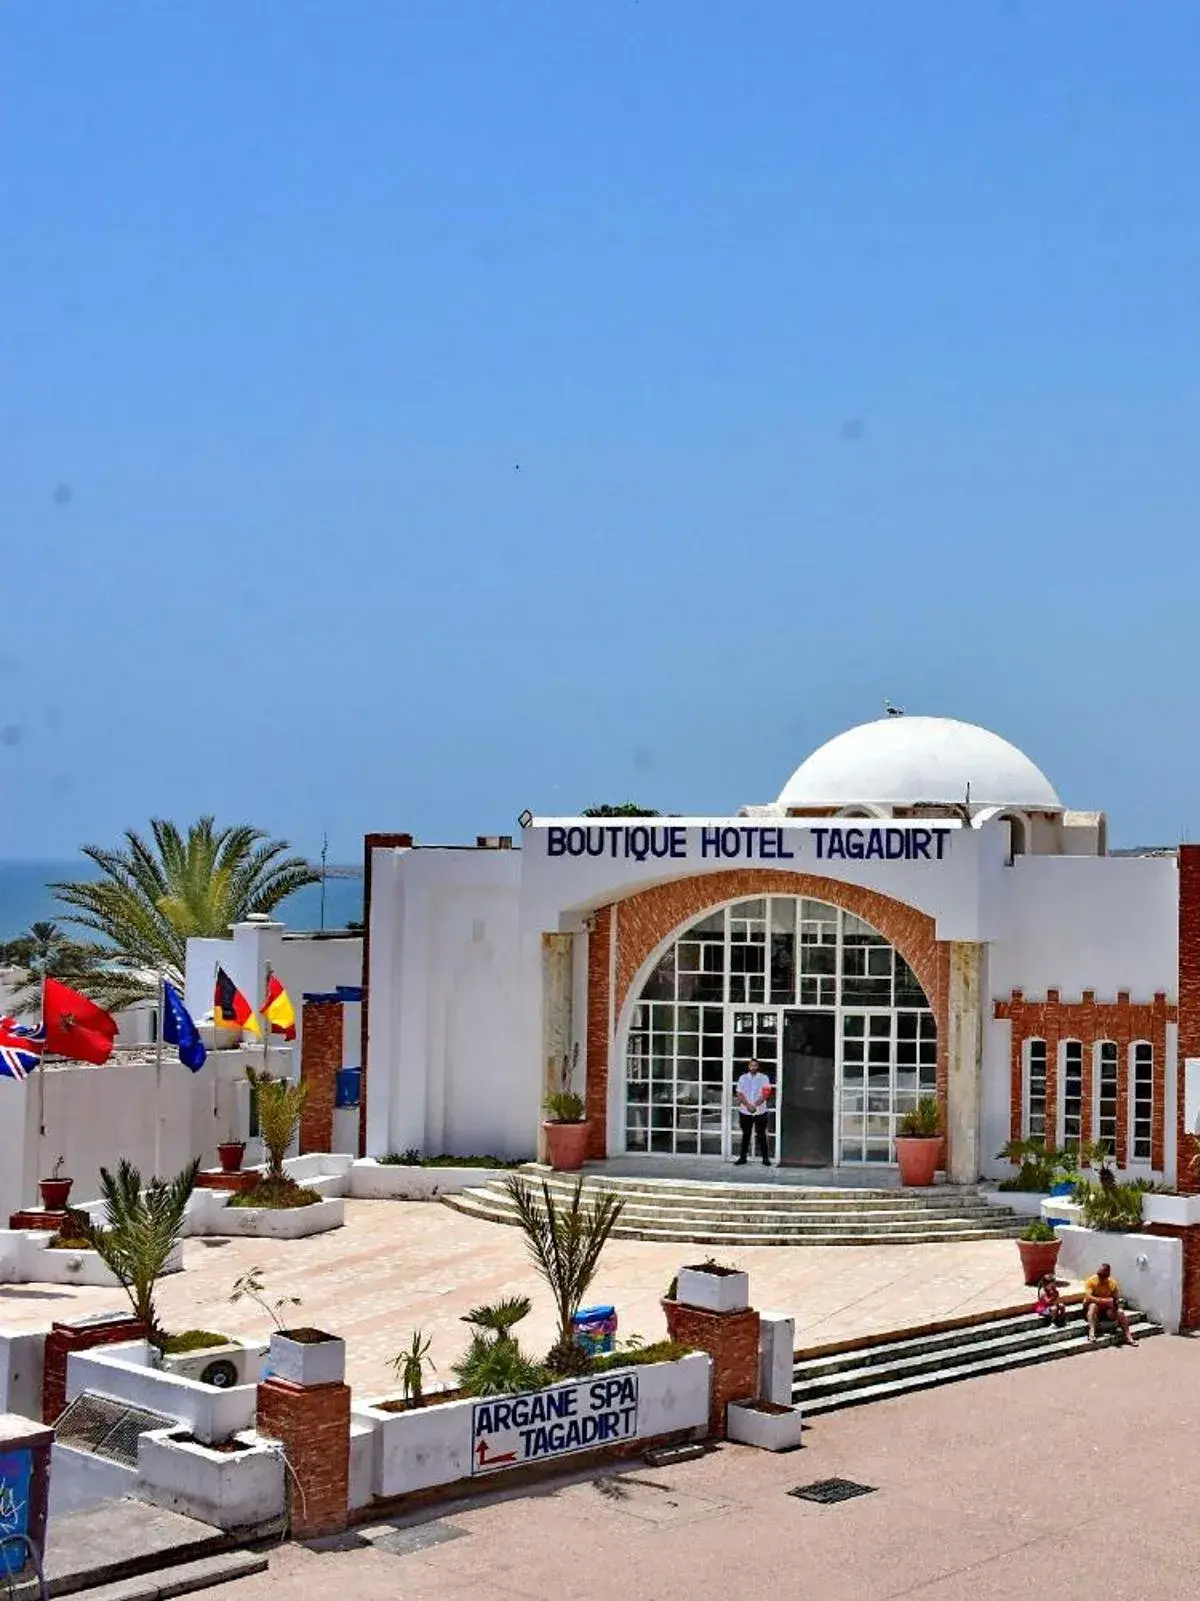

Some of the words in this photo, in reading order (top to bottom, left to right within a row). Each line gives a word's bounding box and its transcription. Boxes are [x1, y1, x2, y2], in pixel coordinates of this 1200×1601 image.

[548, 826, 687, 861] BOUTIQUE
[701, 826, 794, 858] HOTEL
[811, 828, 950, 860] TAGADIRT
[475, 1389, 578, 1437] ARGANE
[589, 1376, 636, 1411] SPA
[519, 1407, 636, 1458] TAGADIRT
